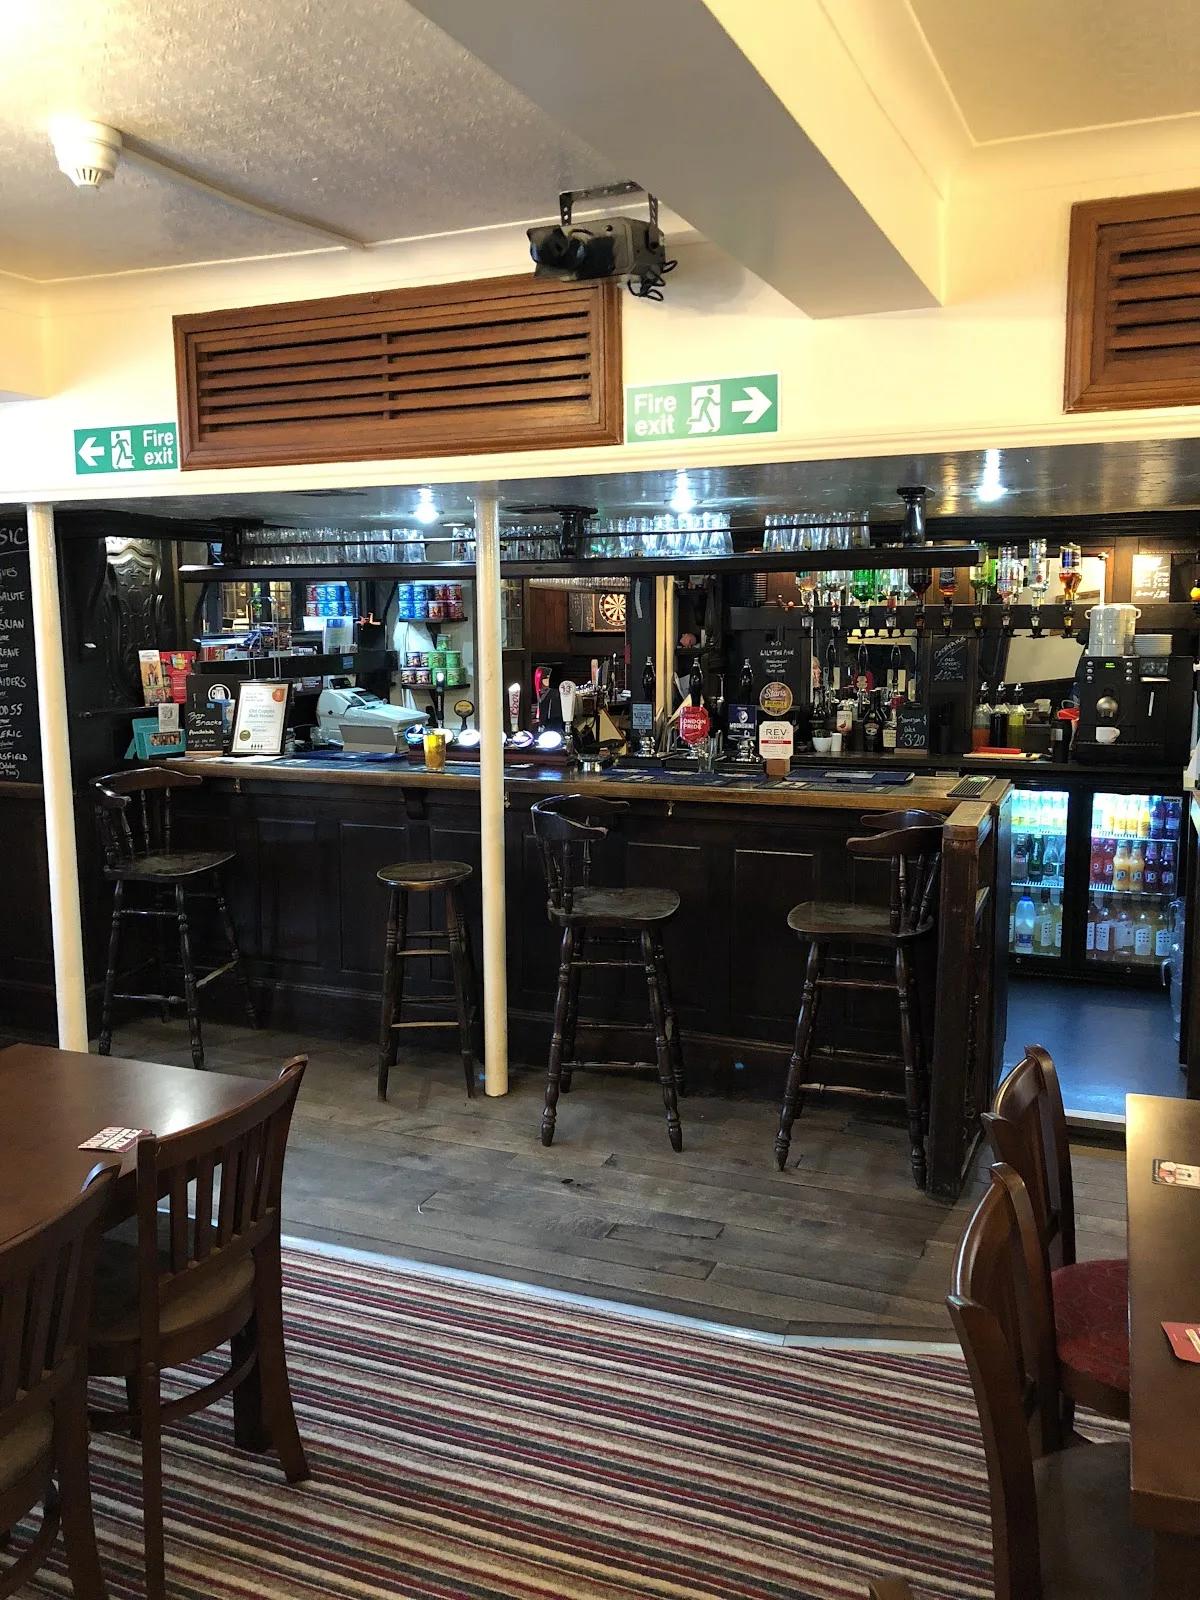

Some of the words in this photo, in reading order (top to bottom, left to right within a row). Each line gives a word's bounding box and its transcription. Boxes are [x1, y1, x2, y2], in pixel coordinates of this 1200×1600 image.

[633, 393, 677, 415] Fire
[634, 413, 676, 436] exit
[143, 429, 174, 447] Fire
[144, 447, 173, 465] exit
[195, 719, 223, 727] Snacks
[765, 728, 787, 736] REV
